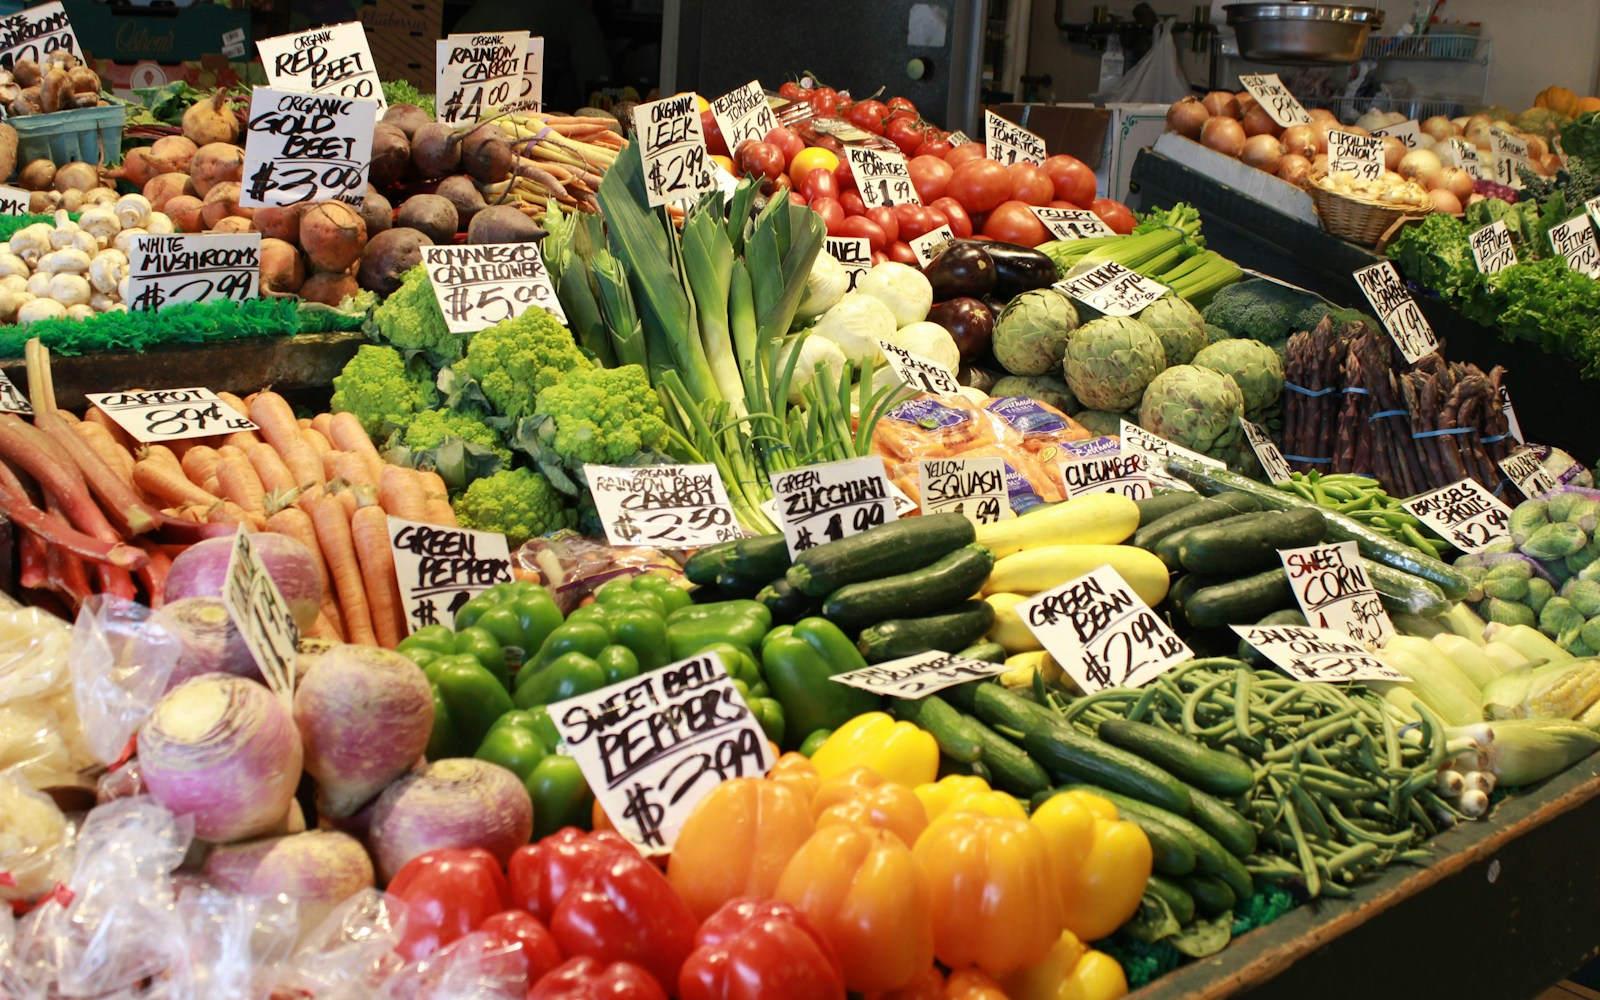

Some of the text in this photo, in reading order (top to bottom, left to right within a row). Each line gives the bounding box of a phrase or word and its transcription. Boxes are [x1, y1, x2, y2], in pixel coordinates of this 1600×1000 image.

[294, 30, 335, 50] ORGANIC
[471, 34, 504, 46] ORGANIC
[275, 45, 328, 77] RED
[448, 44, 516, 65] RAINBOW
[311, 52, 364, 88] BEET
[462, 58, 519, 80] CARROT
[277, 96, 354, 116] ORGANIC
[651, 96, 695, 123] ORGANIC
[714, 85, 752, 116] HEIRLOOM
[726, 89, 765, 121] TOMATOES
[248, 111, 336, 136] GOLD
[646, 116, 699, 152] LEEK
[281, 135, 357, 160] BEET
[989, 126, 1045, 160] TOMATOES
[1336, 146, 1378, 161] ONIONS
[851, 149, 882, 163] ROMA
[858, 162, 908, 175] TOMATOES
[695, 170, 710, 189] LB
[1037, 209, 1093, 220] CELERY
[138, 236, 185, 253] WHITE
[1472, 225, 1495, 249] GREEN
[1480, 229, 1509, 261] LETTUCE
[1552, 224, 1570, 244] RED
[1558, 226, 1594, 254] LETTUCE
[140, 246, 259, 273] MUSHROOMS
[427, 244, 539, 266] ROMANESCO
[1060, 261, 1127, 298] ARTICHOKE
[1359, 264, 1393, 296] PURPLE
[100, 389, 204, 405] CARROT
[226, 418, 256, 429] LB
[1124, 425, 1168, 447] ENGLISH
[631, 468, 687, 478] ORGANIC
[776, 470, 821, 494] GREEN
[924, 460, 966, 479] YELLOW
[1065, 453, 1147, 488] CUCUMBER
[597, 474, 713, 492] RAINBOW BABY
[927, 470, 1003, 501] SQUASH
[620, 490, 716, 510] CARROT
[784, 476, 887, 516] ZUCCHINI
[1410, 482, 1477, 516] BRUSSELS
[1435, 494, 1491, 524] SPROUTS
[394, 526, 475, 558] GREEN
[419, 556, 512, 588] PEPPERS
[1286, 546, 1345, 578] SWEET
[1303, 565, 1367, 606] CORN
[1029, 576, 1105, 627] GREEN
[1071, 589, 1134, 644] BEAN
[1158, 636, 1184, 659] LB
[1248, 627, 1320, 645] SALAD
[1289, 641, 1365, 655] ONION
[562, 677, 660, 745] SWEET
[597, 686, 748, 784] PEPPERS
